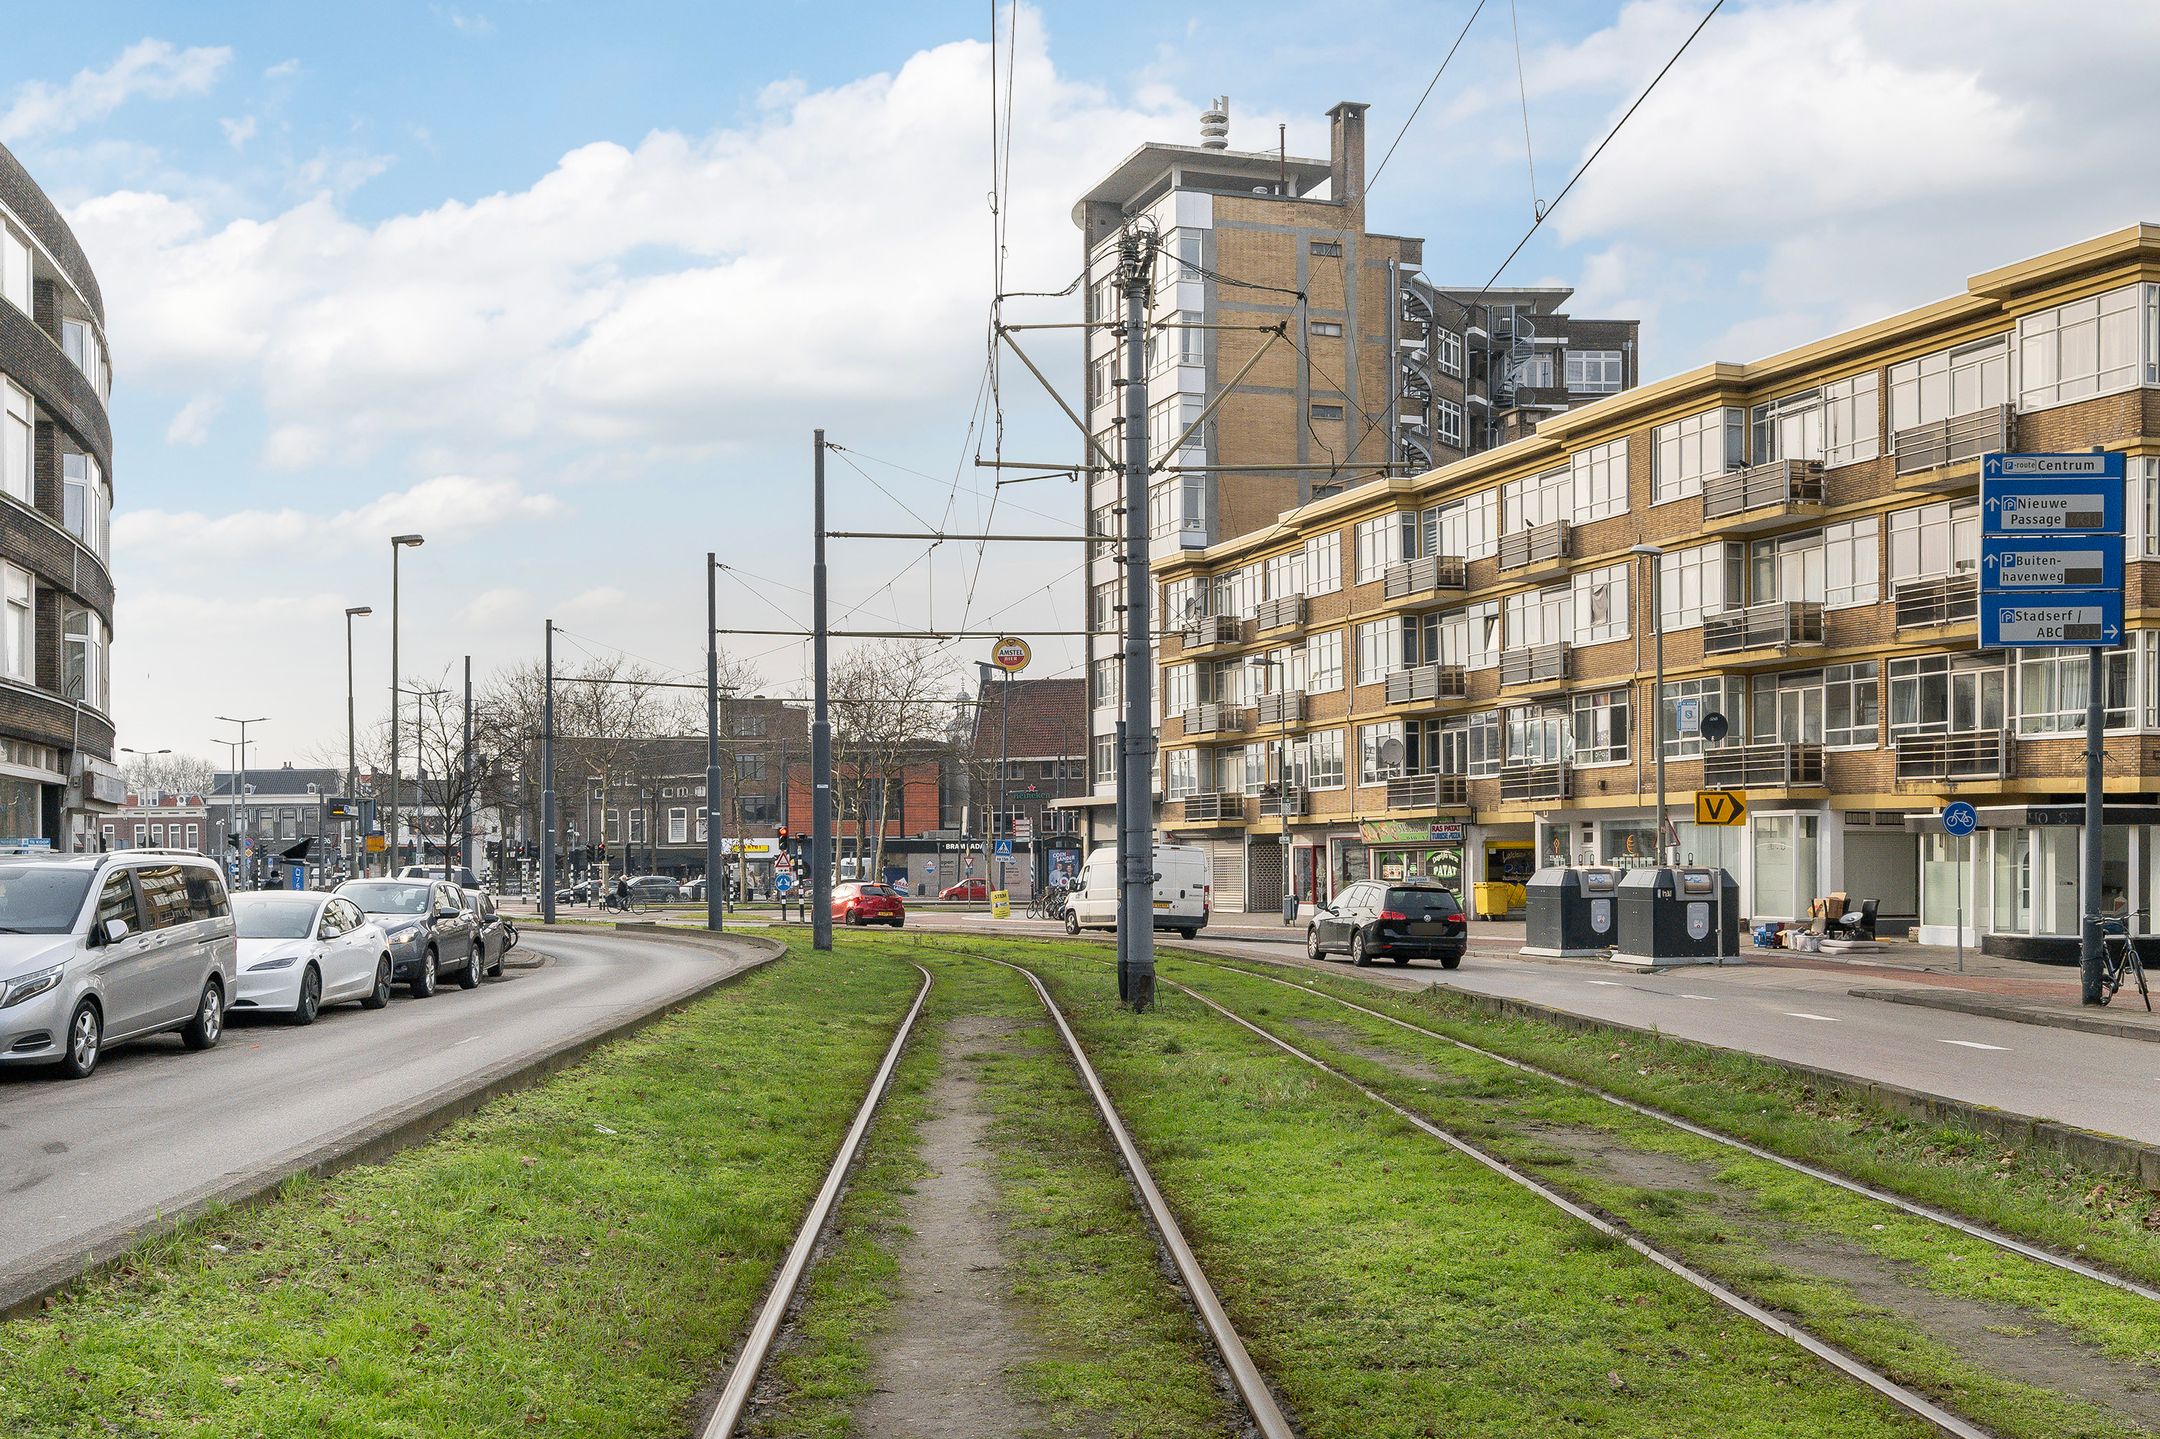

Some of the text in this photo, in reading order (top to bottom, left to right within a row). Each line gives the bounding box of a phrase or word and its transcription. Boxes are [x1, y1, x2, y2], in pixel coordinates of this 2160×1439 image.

[2038, 459, 2095, 471] Centrum
[2018, 497, 2068, 509] Nieuwe
[2011, 513, 2062, 527] Passage
[2016, 555, 2061, 566] Buiten-
[2002, 571, 2064, 583] havenweg
[2015, 609, 2073, 621] Stadserf
[2077, 609, 2082, 624] /
[2036, 627, 2063, 638] ABC
[1704, 798, 1725, 820] V
[1431, 825, 1443, 833] RAS
[1433, 864, 1458, 878] PATAT
